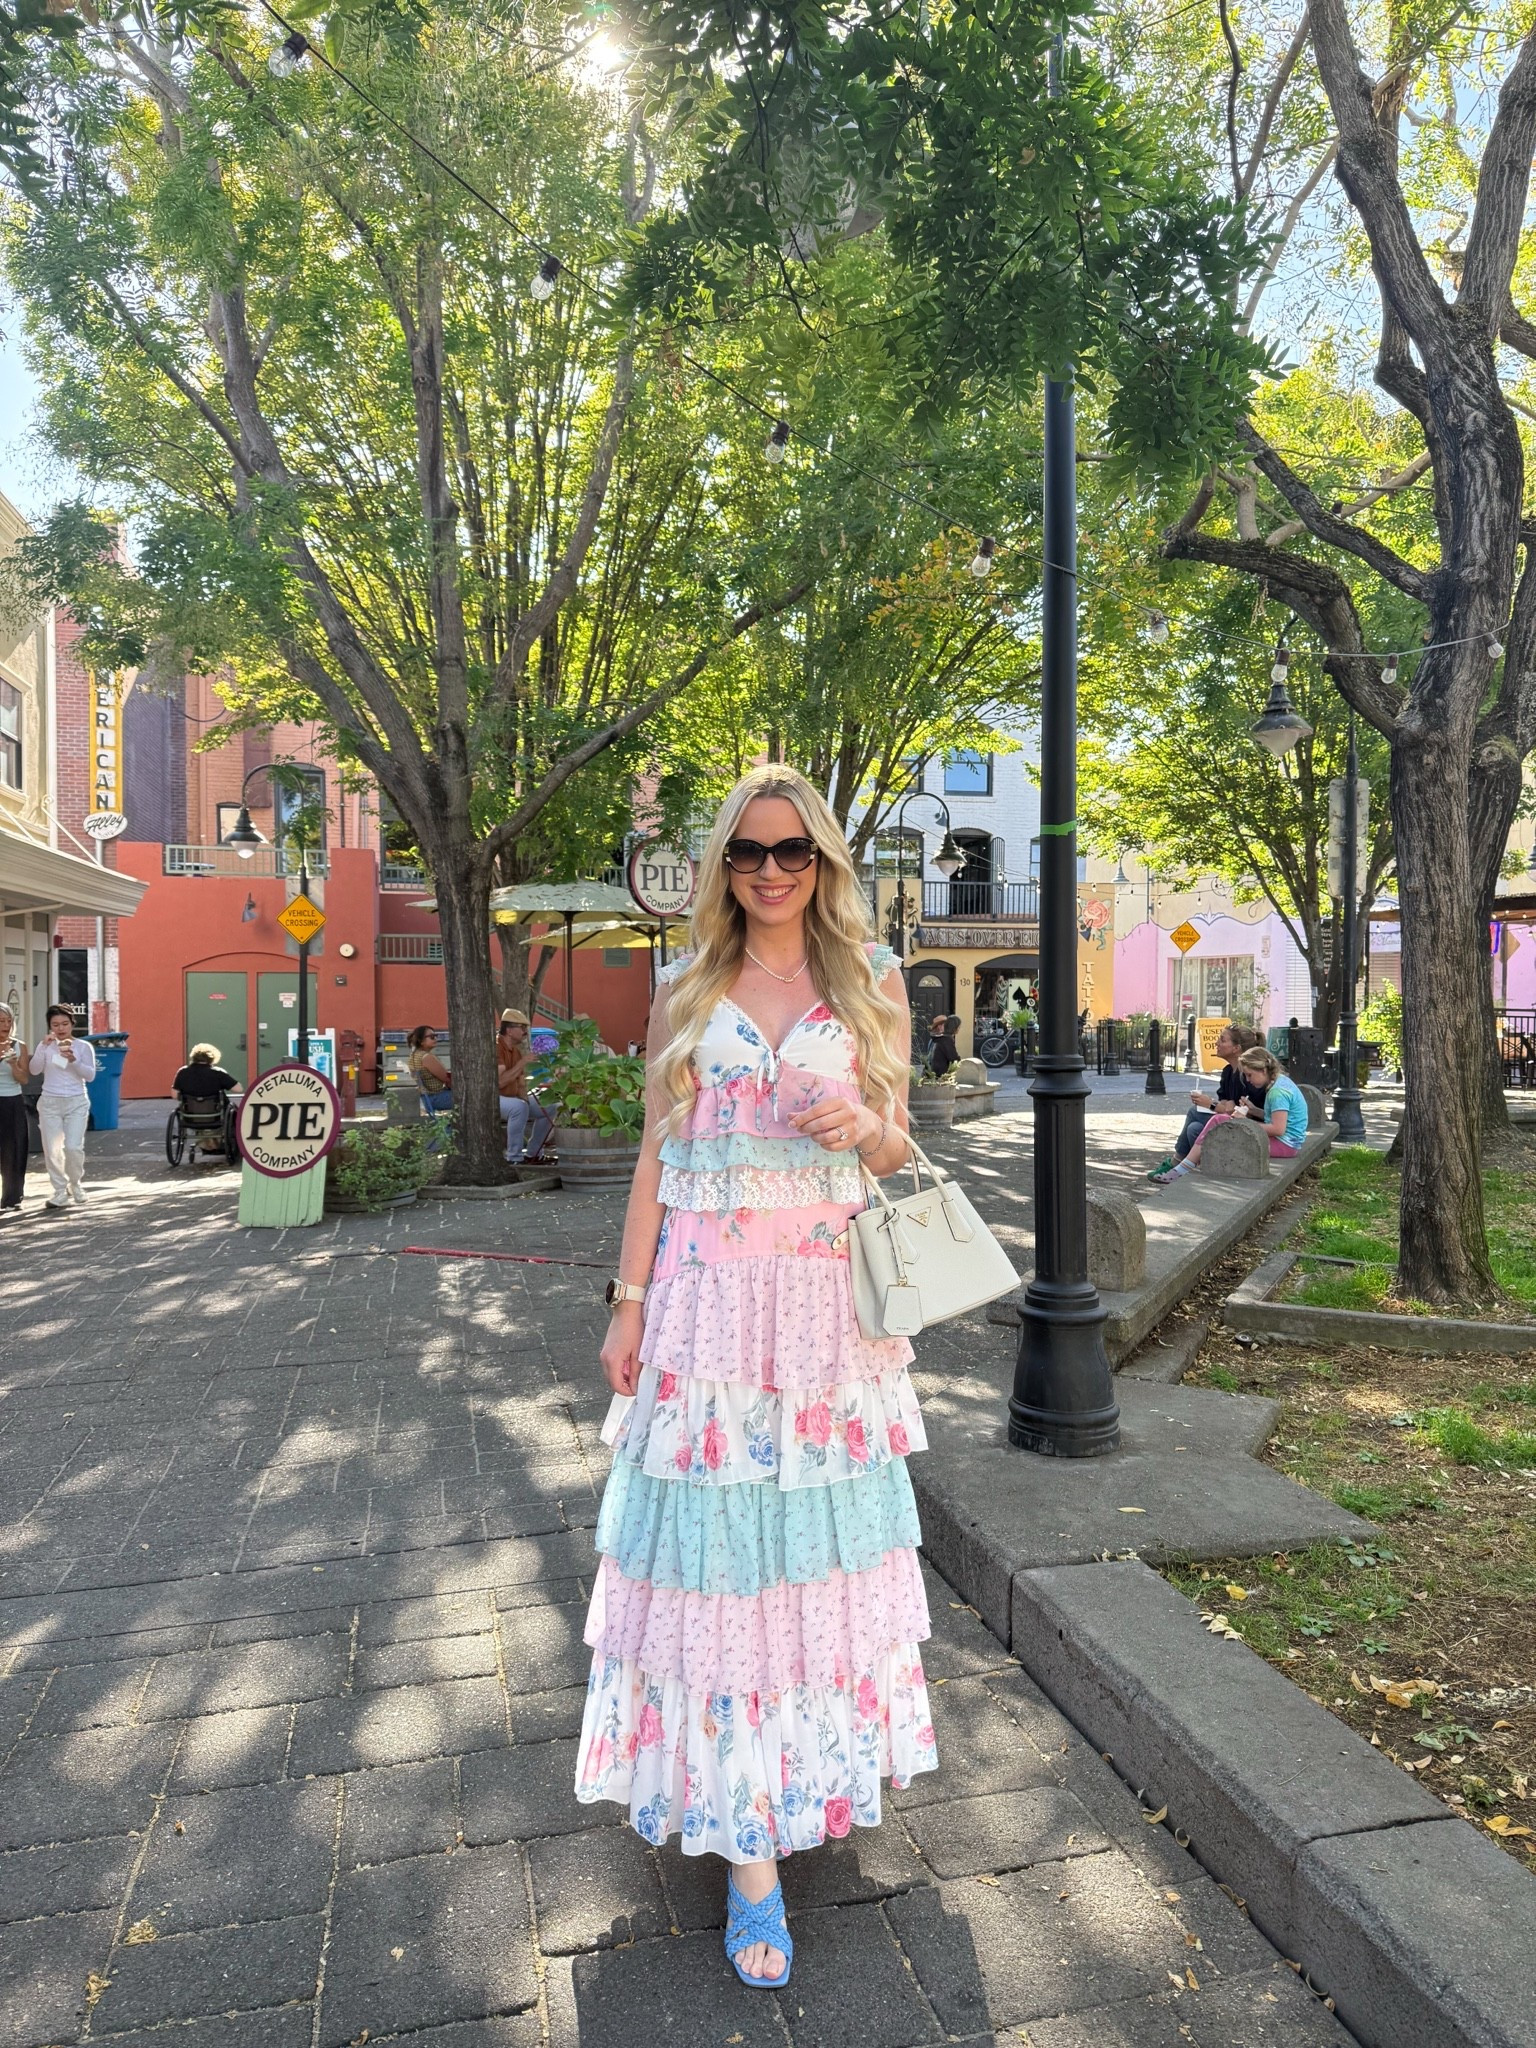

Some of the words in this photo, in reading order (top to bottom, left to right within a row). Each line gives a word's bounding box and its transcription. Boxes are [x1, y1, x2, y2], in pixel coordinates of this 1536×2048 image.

[639, 863, 689, 892] PIE
[287, 909, 316, 917] VEHICLE
[645, 895, 685, 911] COMPANY
[285, 919, 319, 927] CROSSING
[959, 978, 971, 987] 130
[256, 1072, 323, 1098] PETALUMA
[246, 1102, 326, 1141] PIE
[252, 1144, 316, 1168] COMPANY
